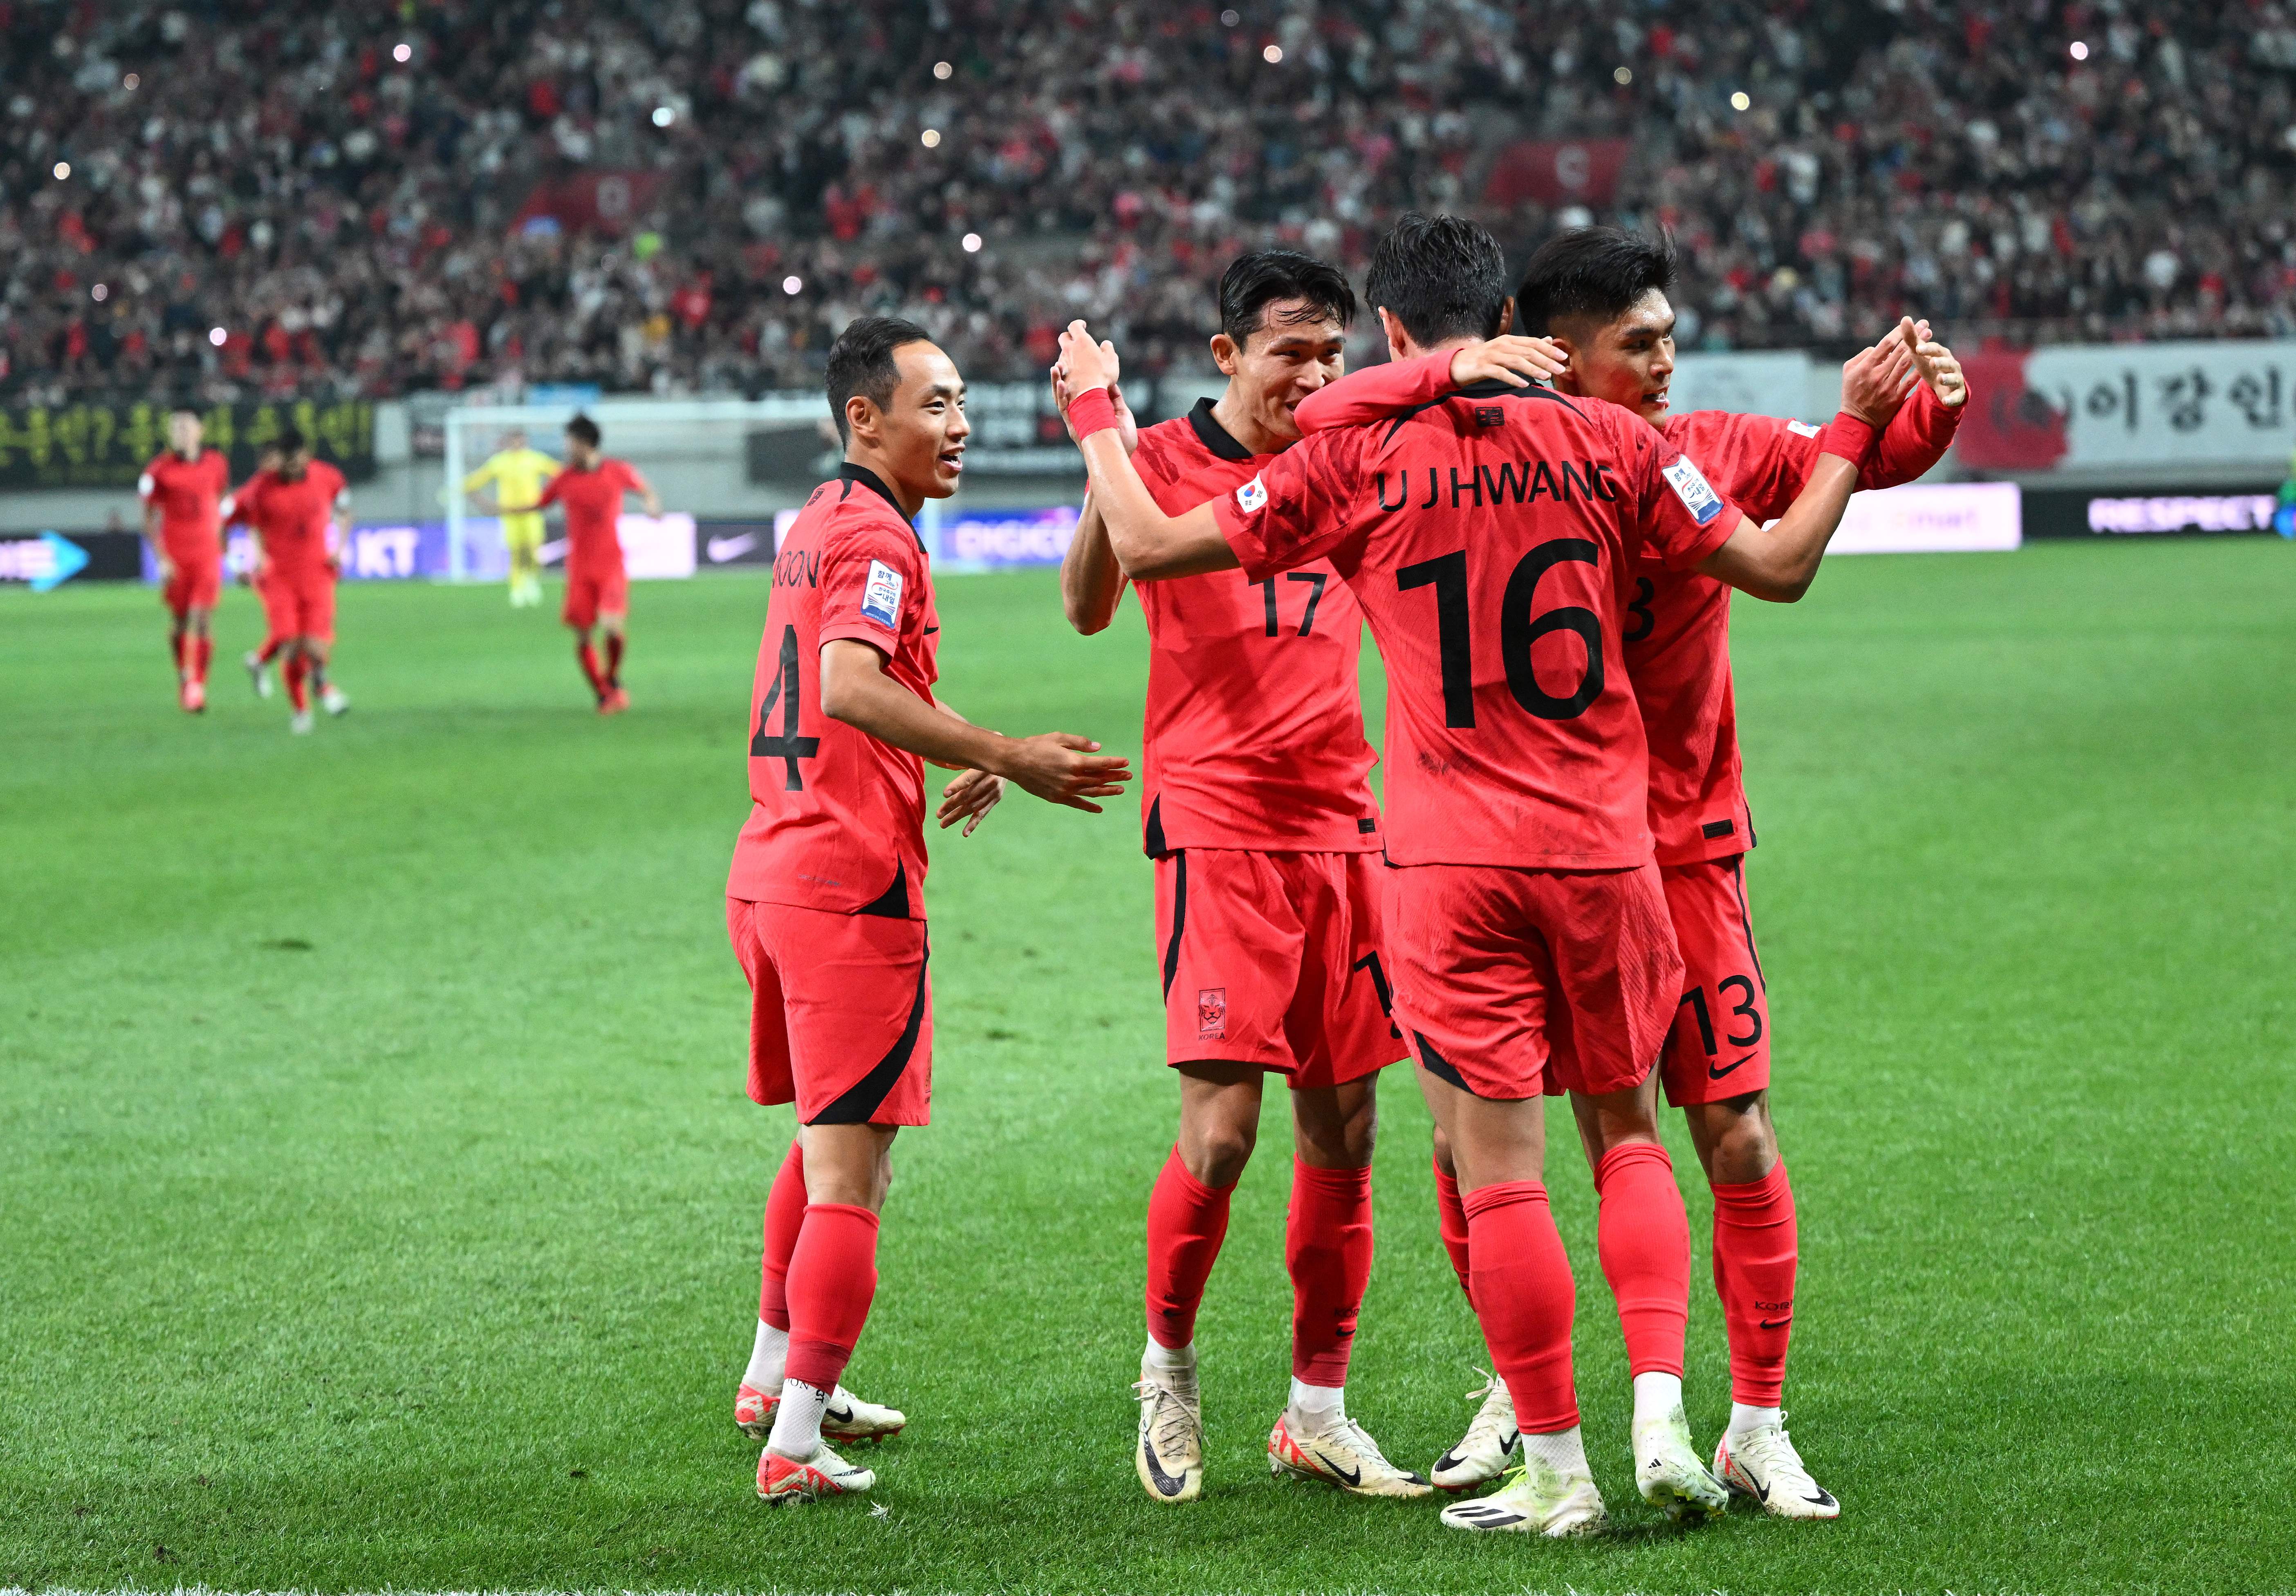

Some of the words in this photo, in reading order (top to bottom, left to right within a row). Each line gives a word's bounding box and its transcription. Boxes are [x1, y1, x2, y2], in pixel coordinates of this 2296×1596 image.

[2087, 495, 2276, 534] RESPECT
[772, 550, 821, 588] OON
[878, 570, 892, 581] 함께
[882, 593, 895, 605] 내일
[1248, 572, 1327, 637] 17
[1396, 538, 1605, 729] 16
[751, 624, 820, 791] 4
[1353, 950, 1395, 1018] 1
[1679, 975, 1762, 1056] 13
[1198, 1032, 1225, 1041] KOREA
[1755, 1299, 1793, 1311] KOR
